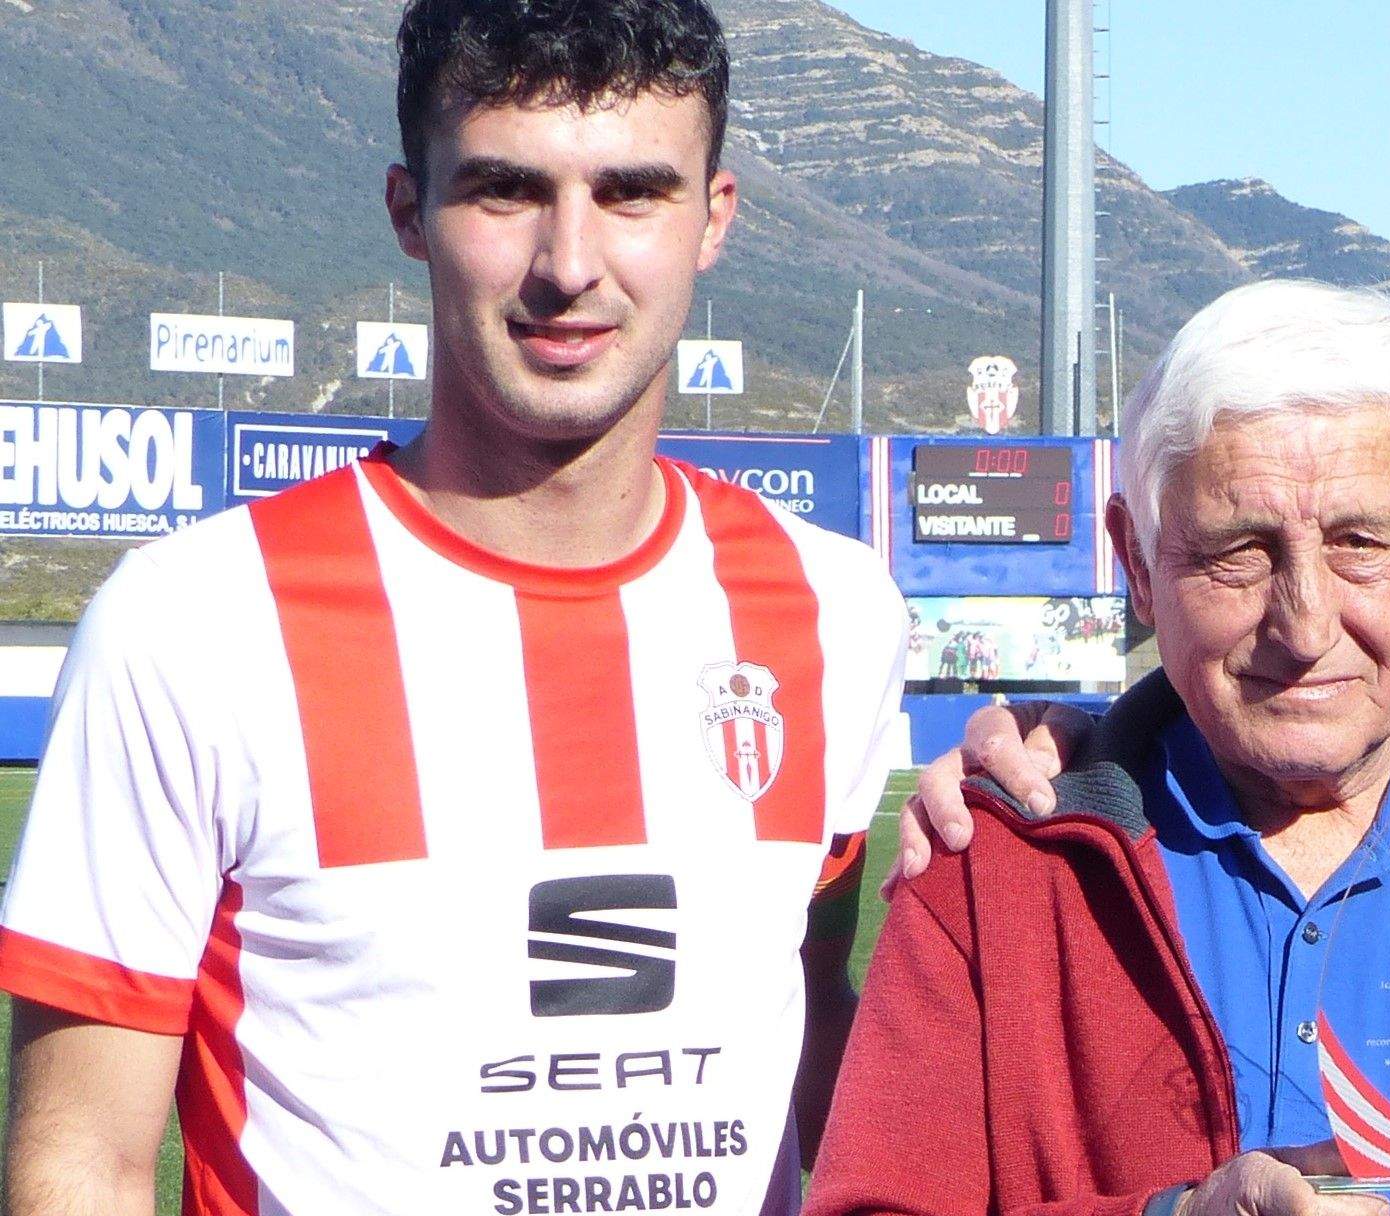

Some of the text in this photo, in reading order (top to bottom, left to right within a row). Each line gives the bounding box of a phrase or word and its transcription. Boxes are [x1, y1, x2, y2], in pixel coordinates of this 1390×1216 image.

[157, 324, 290, 363] Pirenarium
[253, 442, 370, 481] CARAVANI
[917, 482, 1071, 505] LOCAL 0
[918, 514, 1071, 536] VISITANTE 0
[480, 1046, 722, 1094] SEAT
[440, 1112, 748, 1168] AUTOMÓVILES
[493, 1171, 718, 1216] SERRABLO
